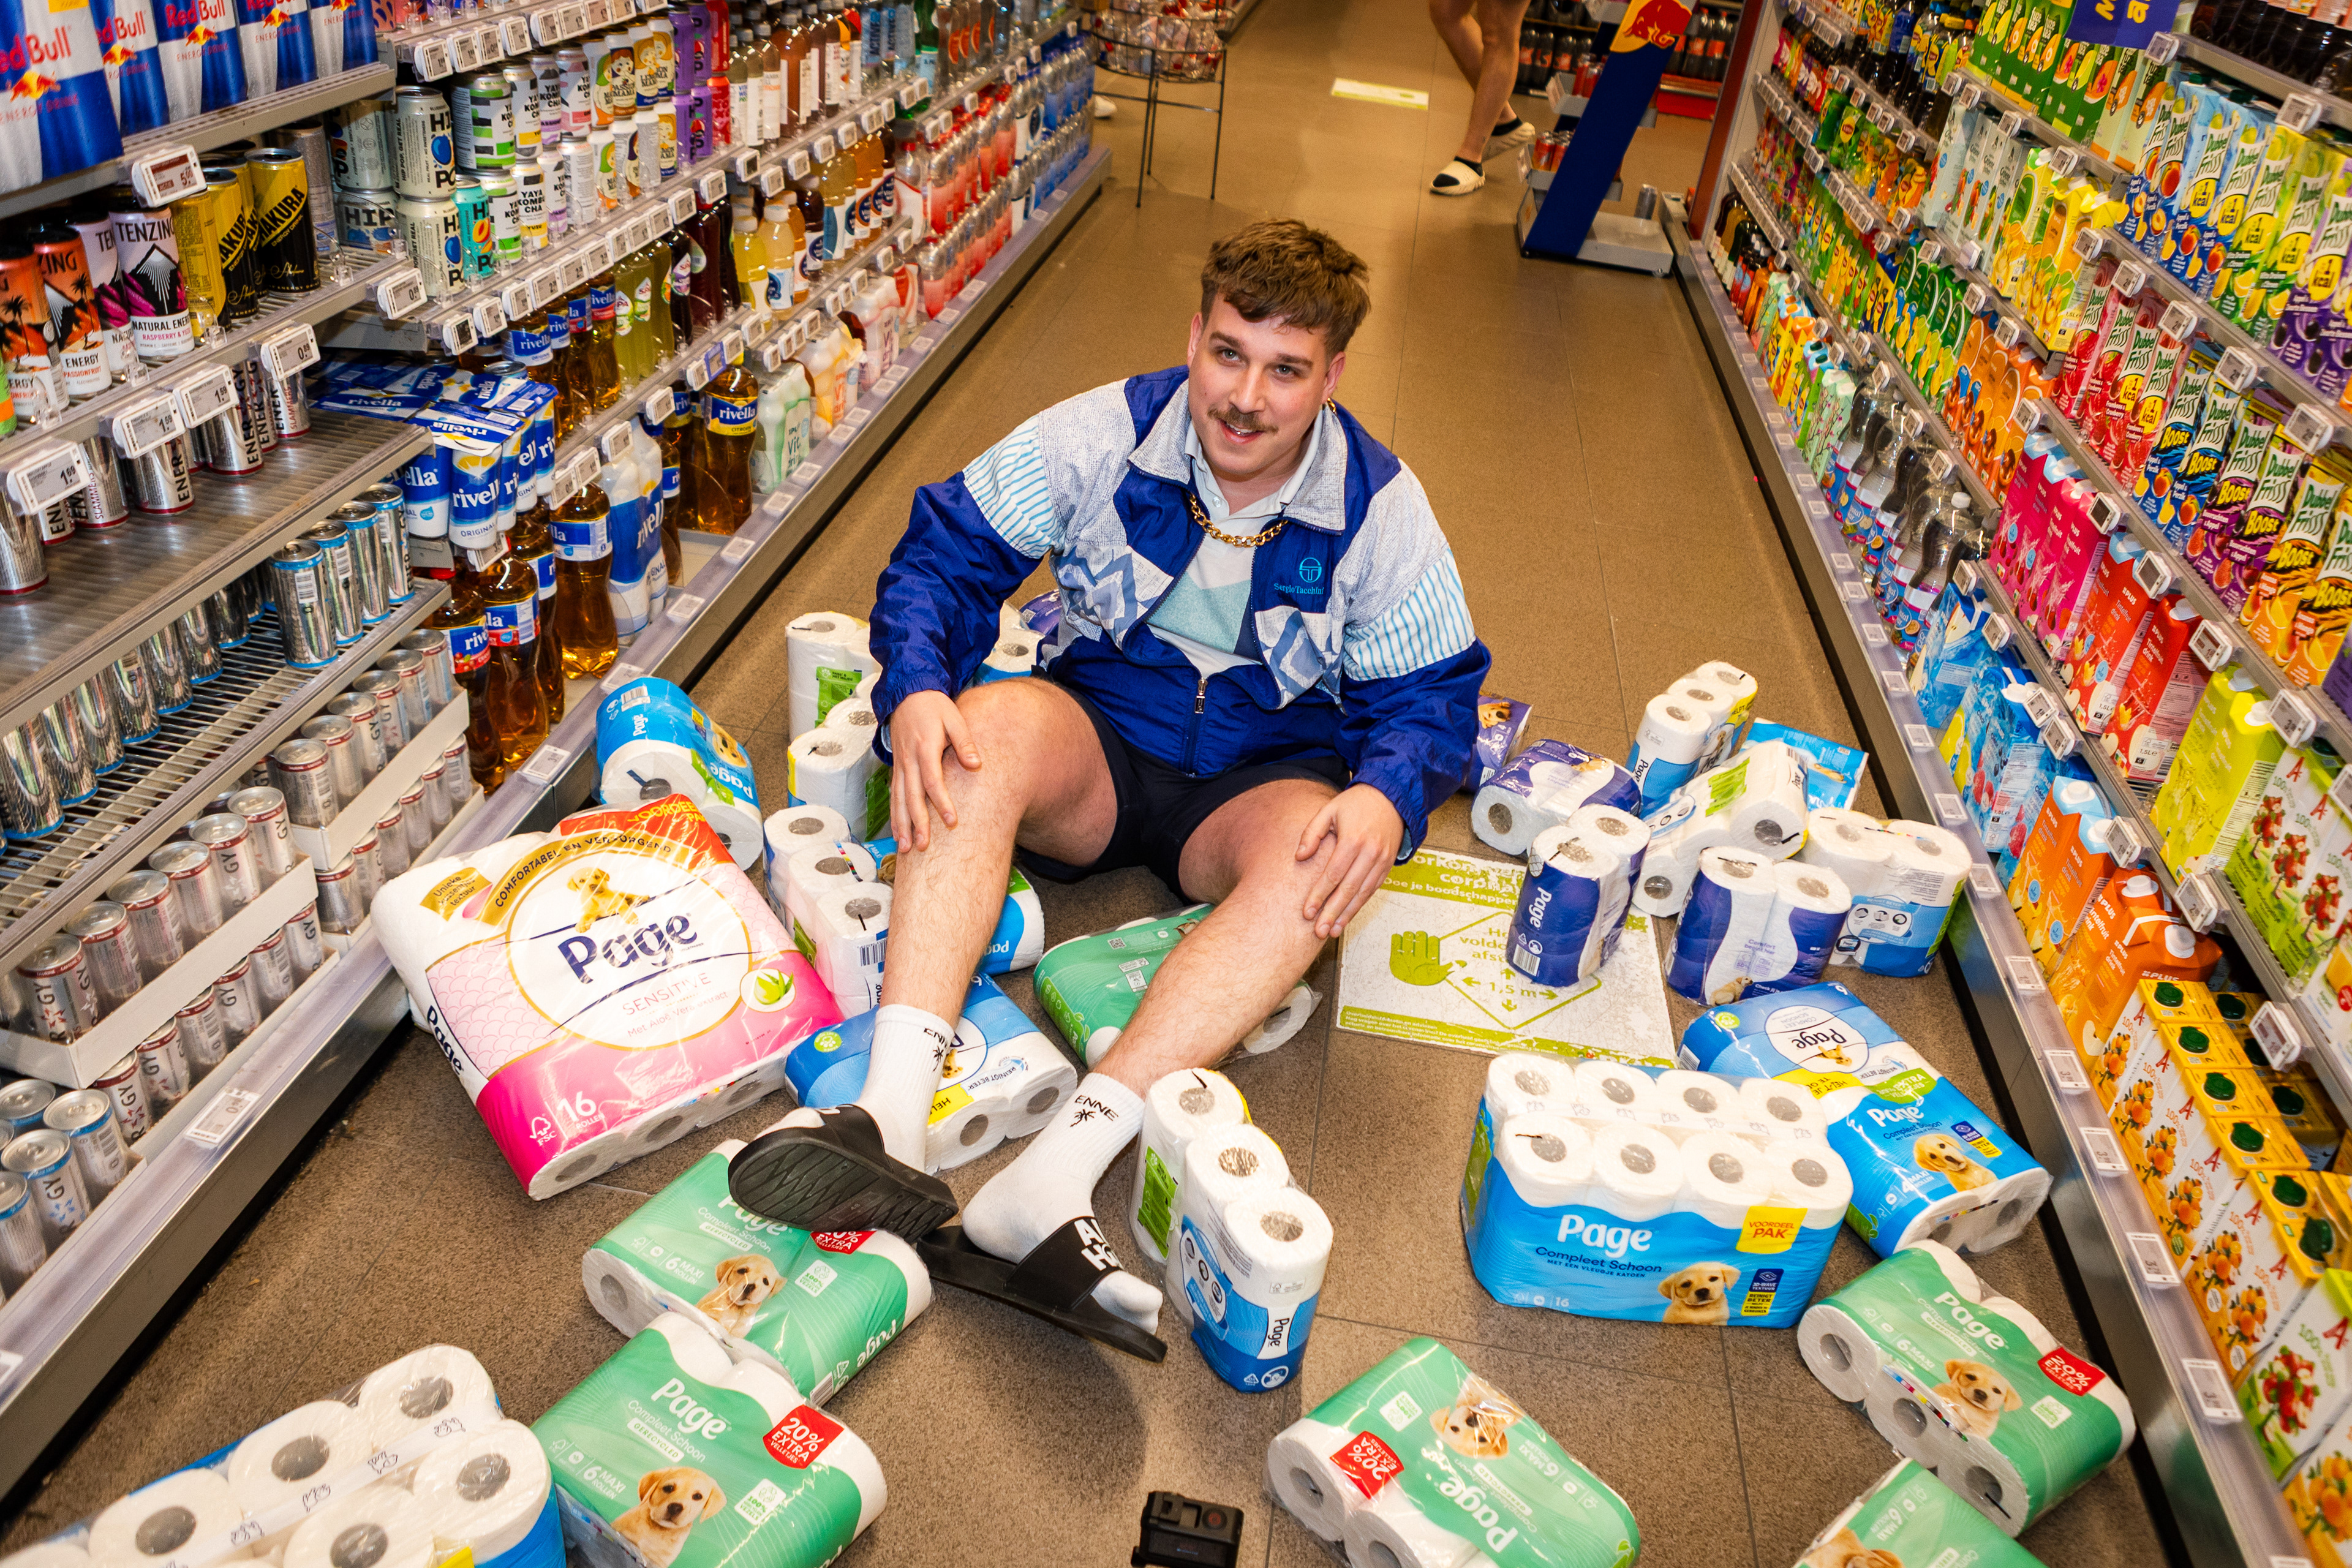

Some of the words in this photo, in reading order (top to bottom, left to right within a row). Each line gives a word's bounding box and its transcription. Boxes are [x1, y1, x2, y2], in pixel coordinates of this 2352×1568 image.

[115, 11, 146, 39] Bull
[165, 2, 196, 28] Red
[323, 14, 346, 26] ENERGY
[25, 25, 71, 64] Bull
[255, 31, 281, 43] ENERGY
[177, 48, 206, 62] ENERGY
[132, 318, 170, 332] NATURAL
[142, 333, 176, 341] RASPBERRY
[520, 335, 551, 350] rivella
[2133, 330, 2158, 350] Dubbel
[66, 353, 99, 368] ENERGY
[2154, 351, 2178, 369] Dubbel
[63, 366, 102, 378] PASSIONFRUIT
[2179, 376, 2206, 396] Dubbel
[348, 398, 402, 409] rivella
[720, 405, 756, 421] rivella
[2207, 400, 2236, 421] Dubbel
[432, 420, 489, 437] rivella
[2238, 426, 2269, 449] Dubbel
[2266, 454, 2299, 477] Dubbel
[460, 521, 497, 538] ORIGINAL
[1274, 583, 1295, 594] Sergio
[1295, 586, 1324, 594] Tacchini
[633, 714, 647, 736] Page
[710, 762, 753, 799] Page
[1634, 759, 1649, 783] Page
[495, 850, 563, 907] COMFORTABEL
[564, 841, 582, 852] EN
[434, 875, 462, 897] Unieke
[450, 886, 475, 907] textuur
[1410, 881, 1423, 891] je
[1529, 887, 1553, 929] Page
[2100, 900, 2116, 919] PLUS
[557, 915, 698, 984] Page
[623, 973, 711, 1015] SENSITIVE
[1489, 981, 1515, 997] 1,5
[1521, 989, 1537, 998] m
[627, 1025, 647, 1038] Met
[650, 1012, 671, 1028] Aloë
[427, 1005, 463, 1074] Page
[1791, 1029, 1846, 1049] Page
[967, 1076, 990, 1091] BETER
[990, 1066, 1017, 1081] REINIGT
[557, 1091, 597, 1123] 16
[1074, 1094, 1119, 1121] ENNE
[1867, 1106, 1924, 1127] Page
[536, 1131, 558, 1146] FSC
[698, 1207, 739, 1236] Compleet
[739, 1229, 771, 1253] Schoon
[1749, 1221, 1795, 1230] VOORDEEL
[1753, 1227, 1787, 1238] PAK
[704, 1225, 748, 1249] GERECYCLED
[816, 1234, 853, 1250] EXTRA
[1557, 1214, 1653, 1259] Page
[665, 1257, 681, 1270] 6
[679, 1261, 704, 1279] MAXI
[1536, 1246, 1606, 1267] Compleet
[1608, 1259, 1662, 1273] Schoon
[1581, 1265, 1615, 1275] VLEUGJE
[674, 1268, 698, 1285] ROLLEN
[1555, 1296, 1570, 1307] 16
[1268, 1317, 1289, 1347] Page
[1934, 1292, 2005, 1351] Page
[1897, 1339, 1912, 1352] 6
[1910, 1347, 1936, 1369] MAXI
[2044, 1359, 2084, 1391] EXTRA
[2051, 1355, 2089, 1387] 20%
[651, 1378, 727, 1440] Page
[628, 1400, 670, 1436] Compleet
[670, 1431, 706, 1463] Schoon
[633, 1422, 679, 1459] GERECYCLED
[780, 1417, 825, 1453] 20%
[770, 1441, 799, 1464] VELLETJES
[771, 1433, 810, 1463] EXTRA
[1361, 1437, 1398, 1471] EXTRA
[1370, 1438, 1397, 1464] VELLETJES
[1518, 1444, 1545, 1468] MAXI
[583, 1466, 603, 1480] 6
[1352, 1444, 1383, 1481] 20%
[1542, 1463, 1559, 1477] 6
[592, 1478, 617, 1499] ROLLEN
[599, 1471, 626, 1493] MAXI
[1439, 1476, 1518, 1553] Page
